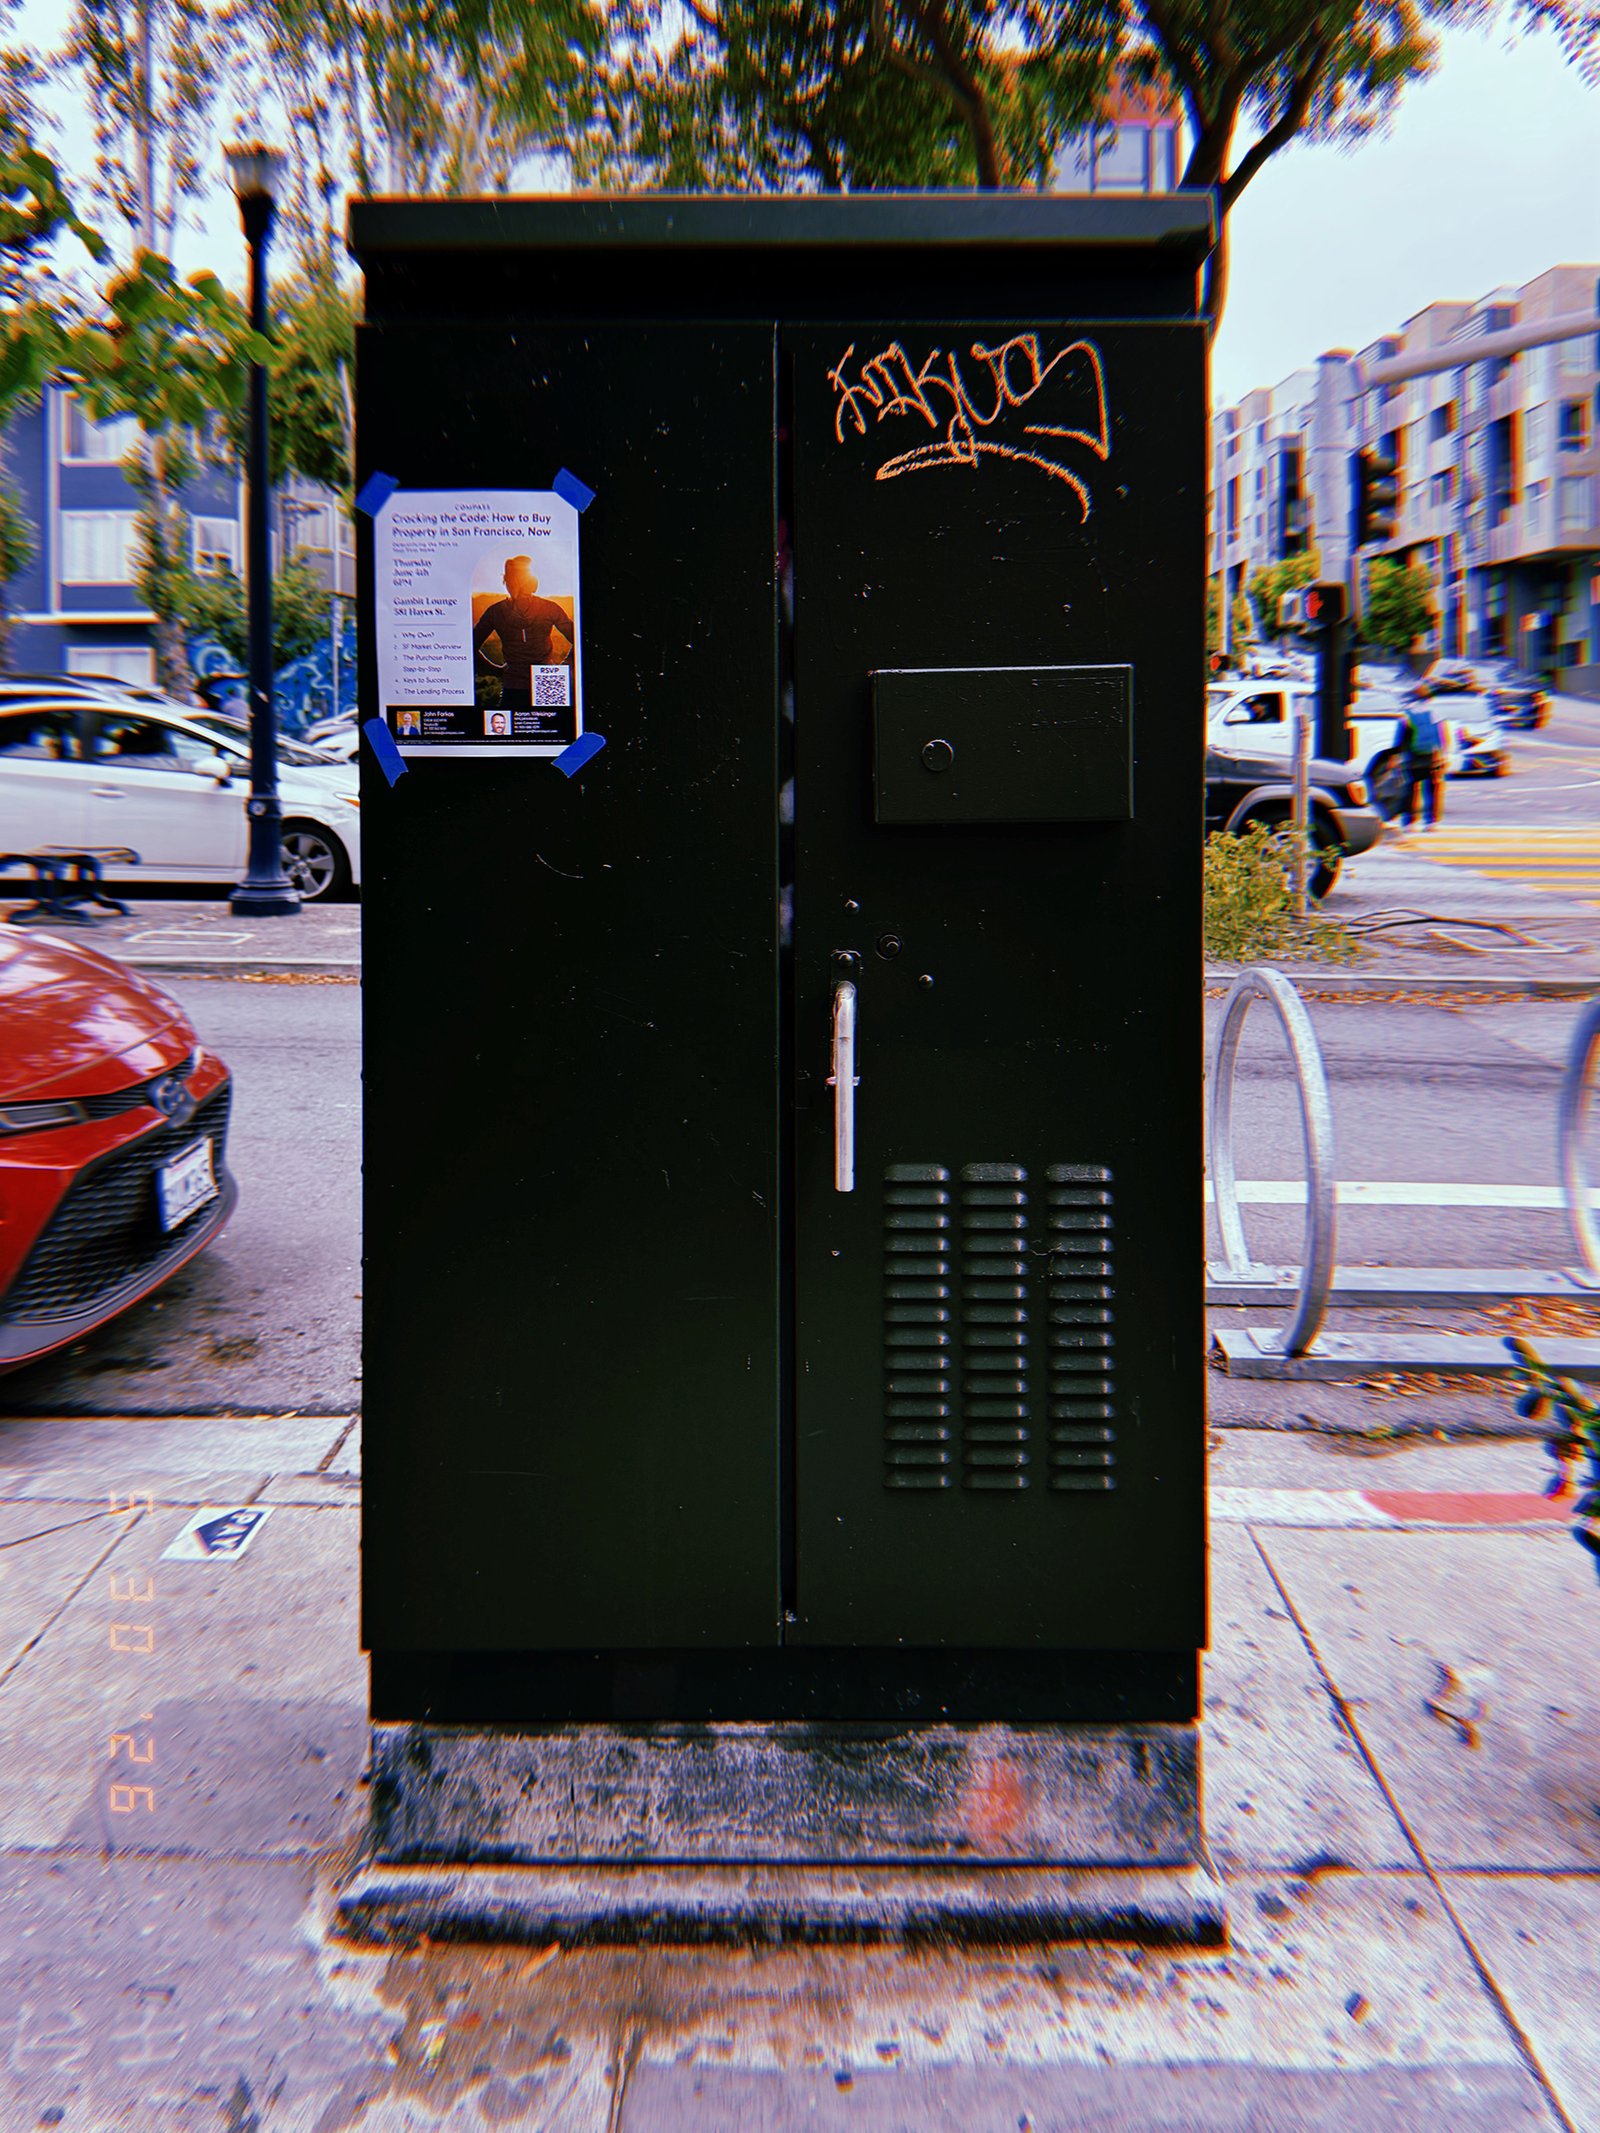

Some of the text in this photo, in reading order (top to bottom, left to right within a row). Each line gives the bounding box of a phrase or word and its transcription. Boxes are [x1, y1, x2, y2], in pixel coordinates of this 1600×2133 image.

[392, 512, 552, 525] Cracking the Code: How to Buy
[392, 526, 551, 539] Property in San Francisco, Now
[392, 558, 432, 568] Thursday
[392, 568, 429, 577] June 4th
[392, 578, 412, 587] 6PM
[393, 596, 458, 607] Gambit Lounge
[409, 607, 433, 617] Hayes
[401, 631, 416, 639] Why
[417, 631, 434, 639] Own?
[416, 688, 441, 696] Lending
[208, 1510, 261, 1554] PAY
